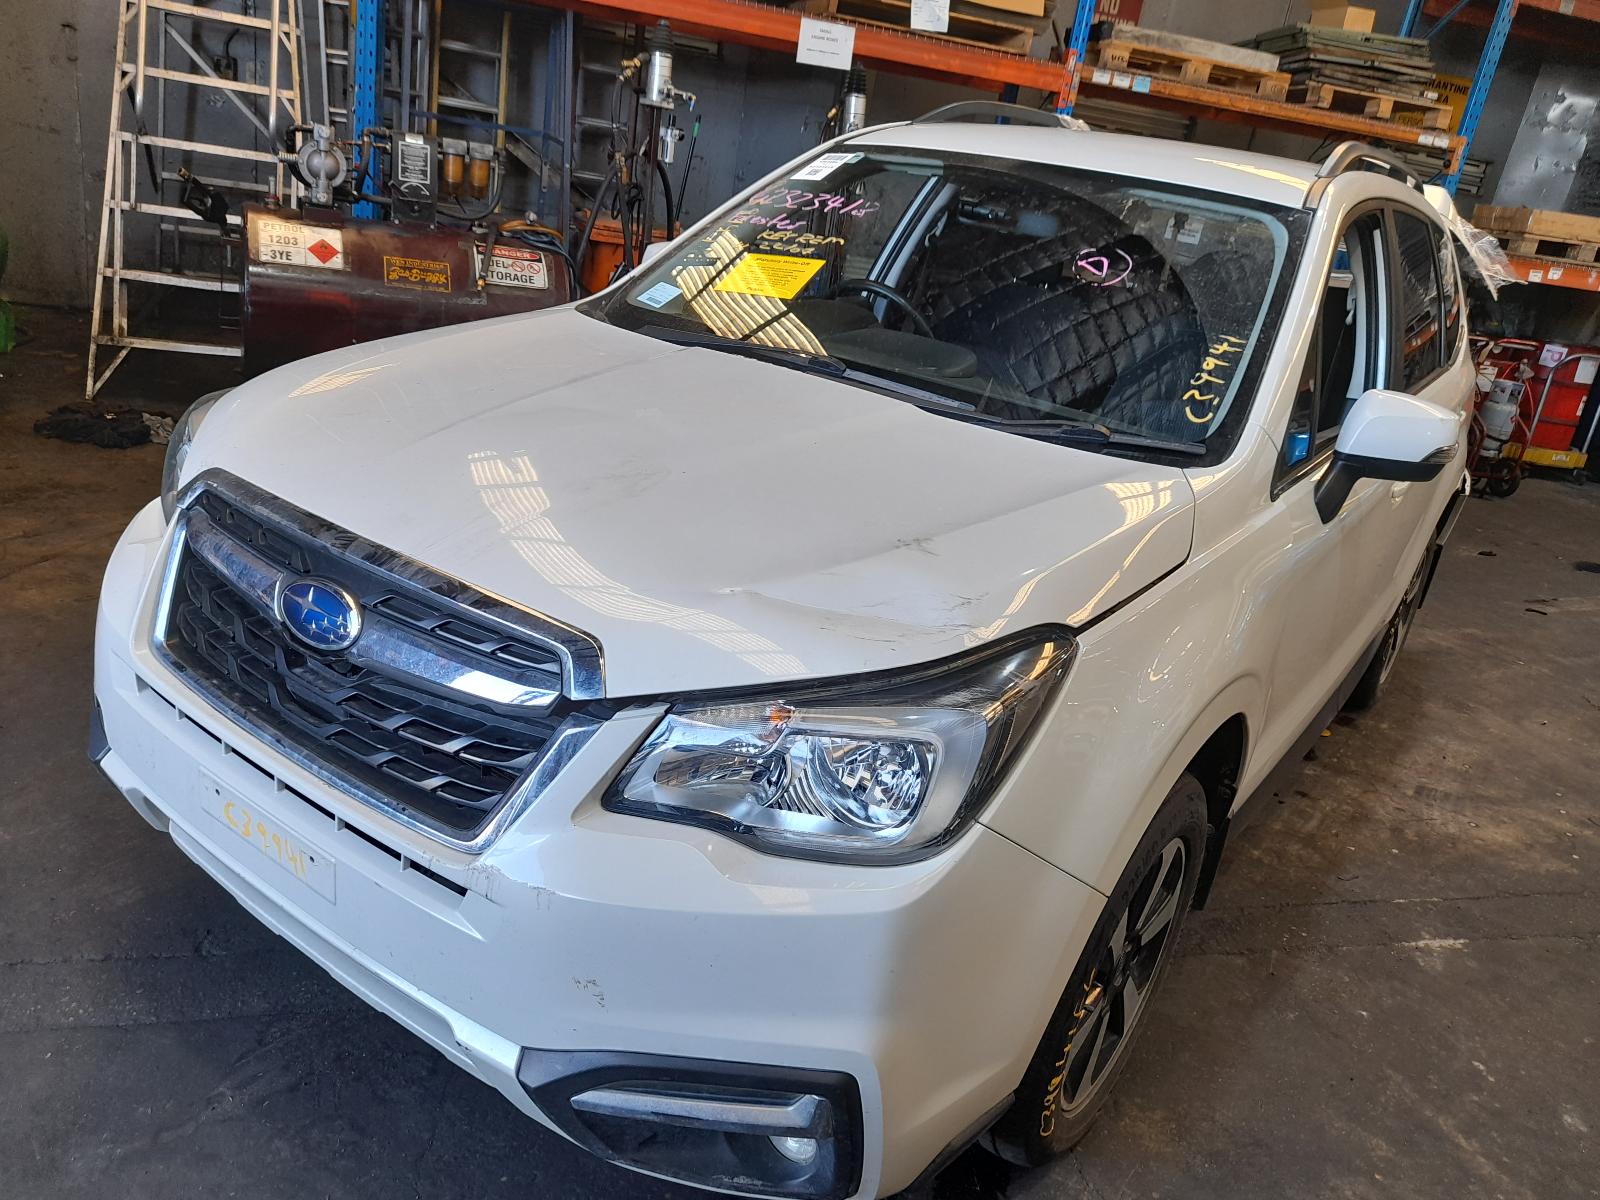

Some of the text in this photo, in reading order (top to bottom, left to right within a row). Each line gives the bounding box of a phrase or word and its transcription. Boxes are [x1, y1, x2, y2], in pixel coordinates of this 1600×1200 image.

[263, 222, 304, 233] PETROL
[268, 234, 298, 246] 1203
[488, 270, 536, 285] TORAGE
